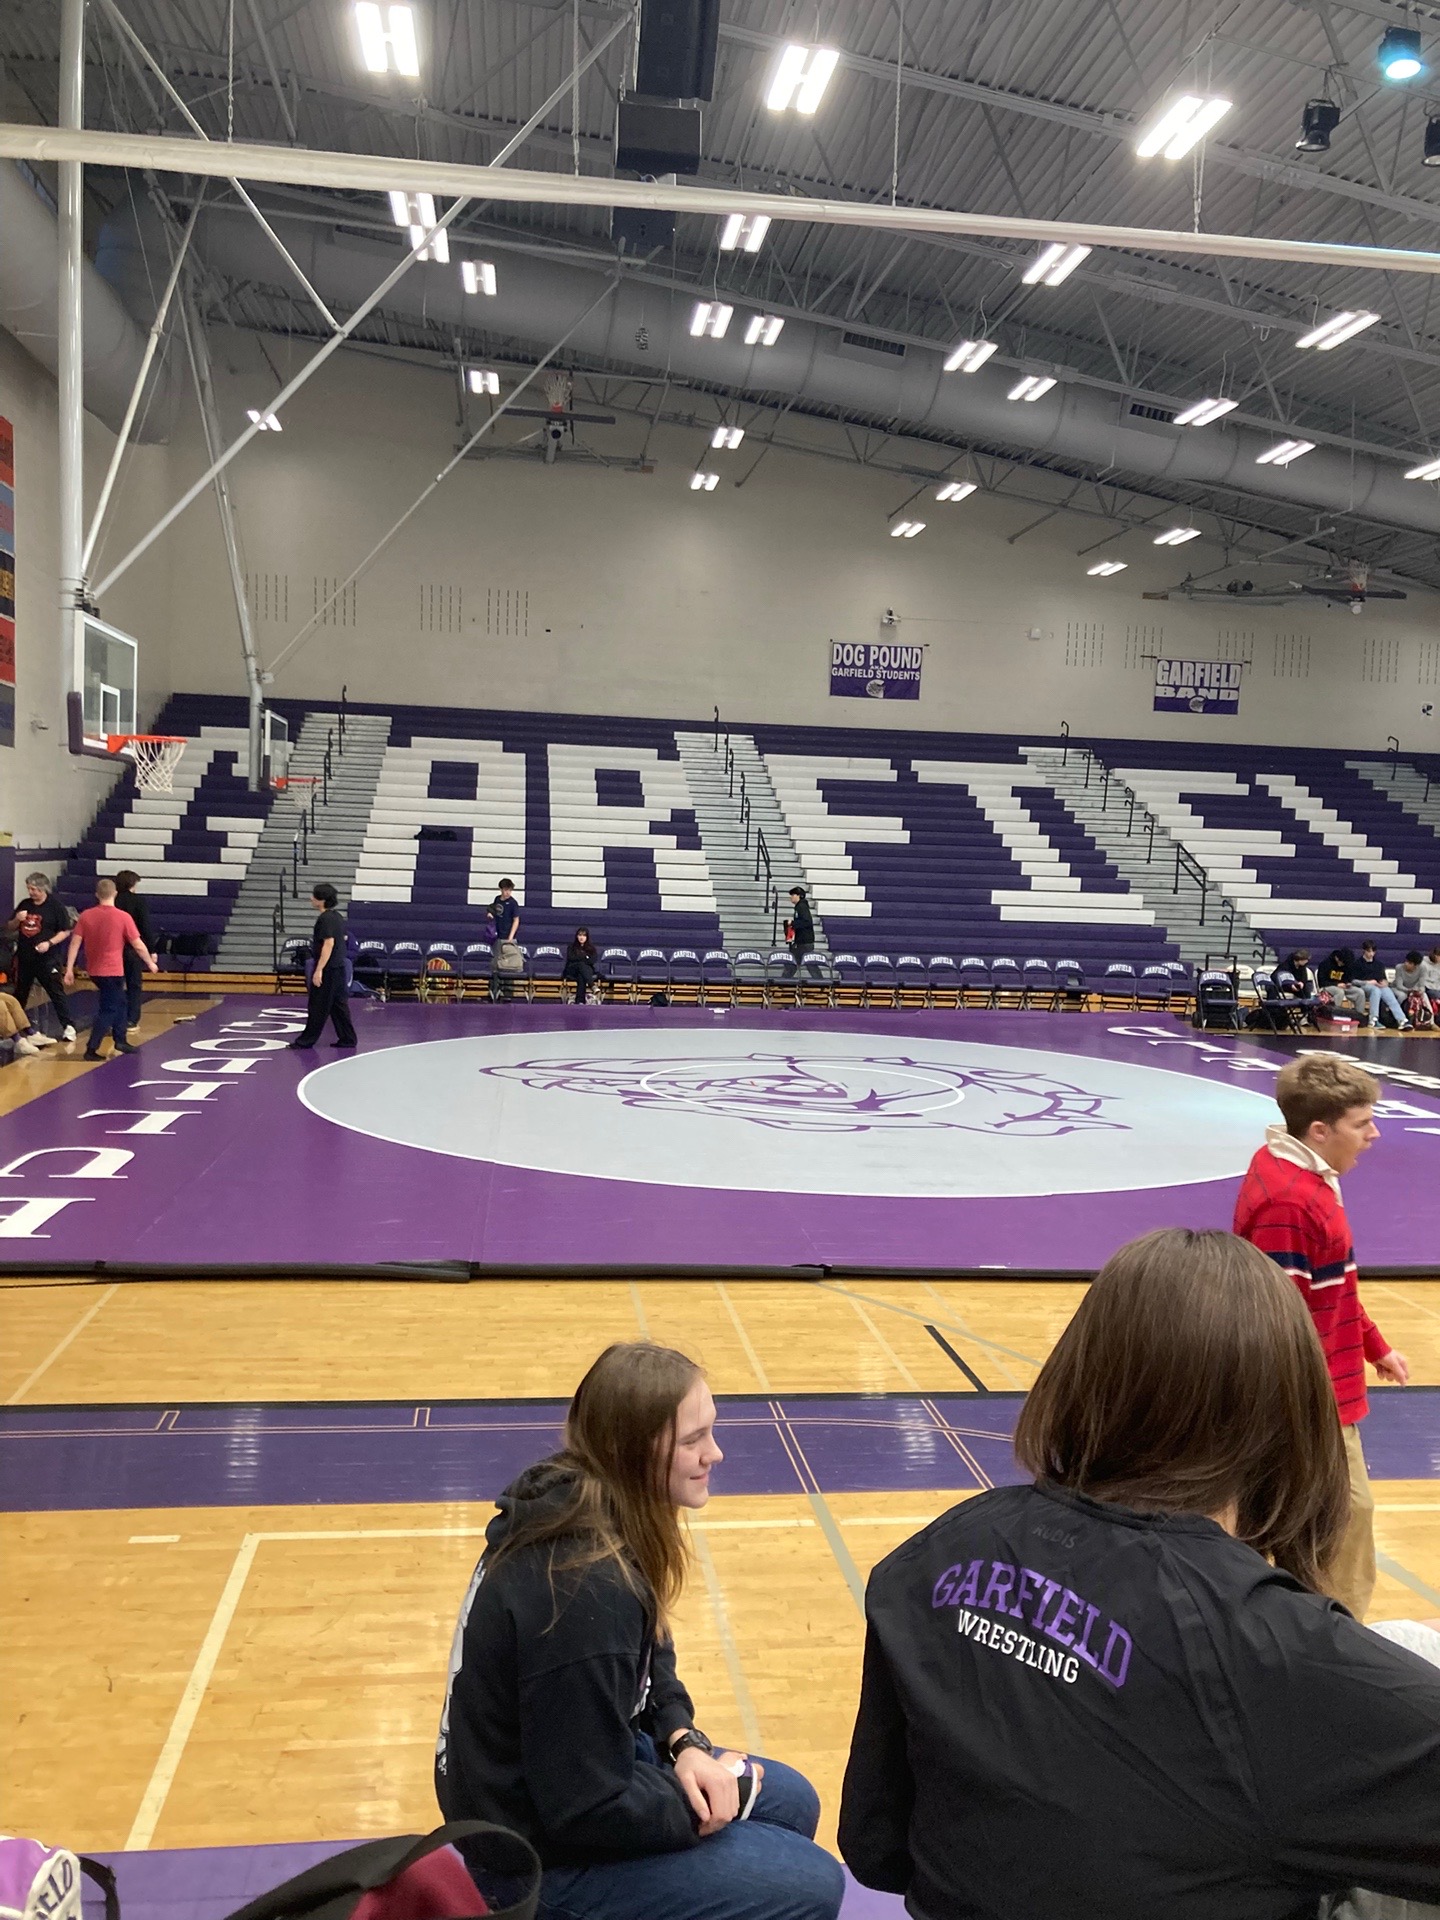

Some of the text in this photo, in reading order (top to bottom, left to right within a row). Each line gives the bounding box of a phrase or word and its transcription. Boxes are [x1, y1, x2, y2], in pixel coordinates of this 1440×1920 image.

[832, 643, 922, 669] DOG POUND
[831, 667, 920, 681] GARFIELD STUDENTS
[1156, 660, 1242, 688] GARFIELD
[1155, 686, 1239, 701] BAND
[360, 941, 385, 950] GARFIELD
[395, 942, 419, 951] GARFIELD
[430, 943, 454, 952] GARFIELD
[467, 944, 491, 953] GARFIELD
[536, 946, 560, 955] GARFIELD
[604, 948, 628, 957] GARFIELD
[640, 949, 663, 958] GARFIELD
[673, 950, 696, 959] GARFIELD
[705, 950, 729, 960] GARFIELD
[738, 951, 761, 960] GARFIELD
[770, 952, 793, 962] GARFIELD
[803, 953, 827, 963] GARFIELD
[835, 954, 858, 963] GARFIELD
[867, 954, 890, 964] GARFIELD
[899, 955, 921, 965] GARFIELD
[931, 956, 953, 965] GARFIELD
[962, 957, 984, 967] GARFIELD
[993, 958, 1016, 967] GARFIELD
[1025, 959, 1048, 968] GARFIELD
[1057, 960, 1079, 969] GARFIELD
[1108, 963, 1132, 973] GARFIELD
[1144, 966, 1169, 976] GARFIELD
[1202, 971, 1227, 981] GARFIELD
[932, 1559, 1132, 1689] GARFIELD
[957, 1609, 1079, 1684] WRESTLING
